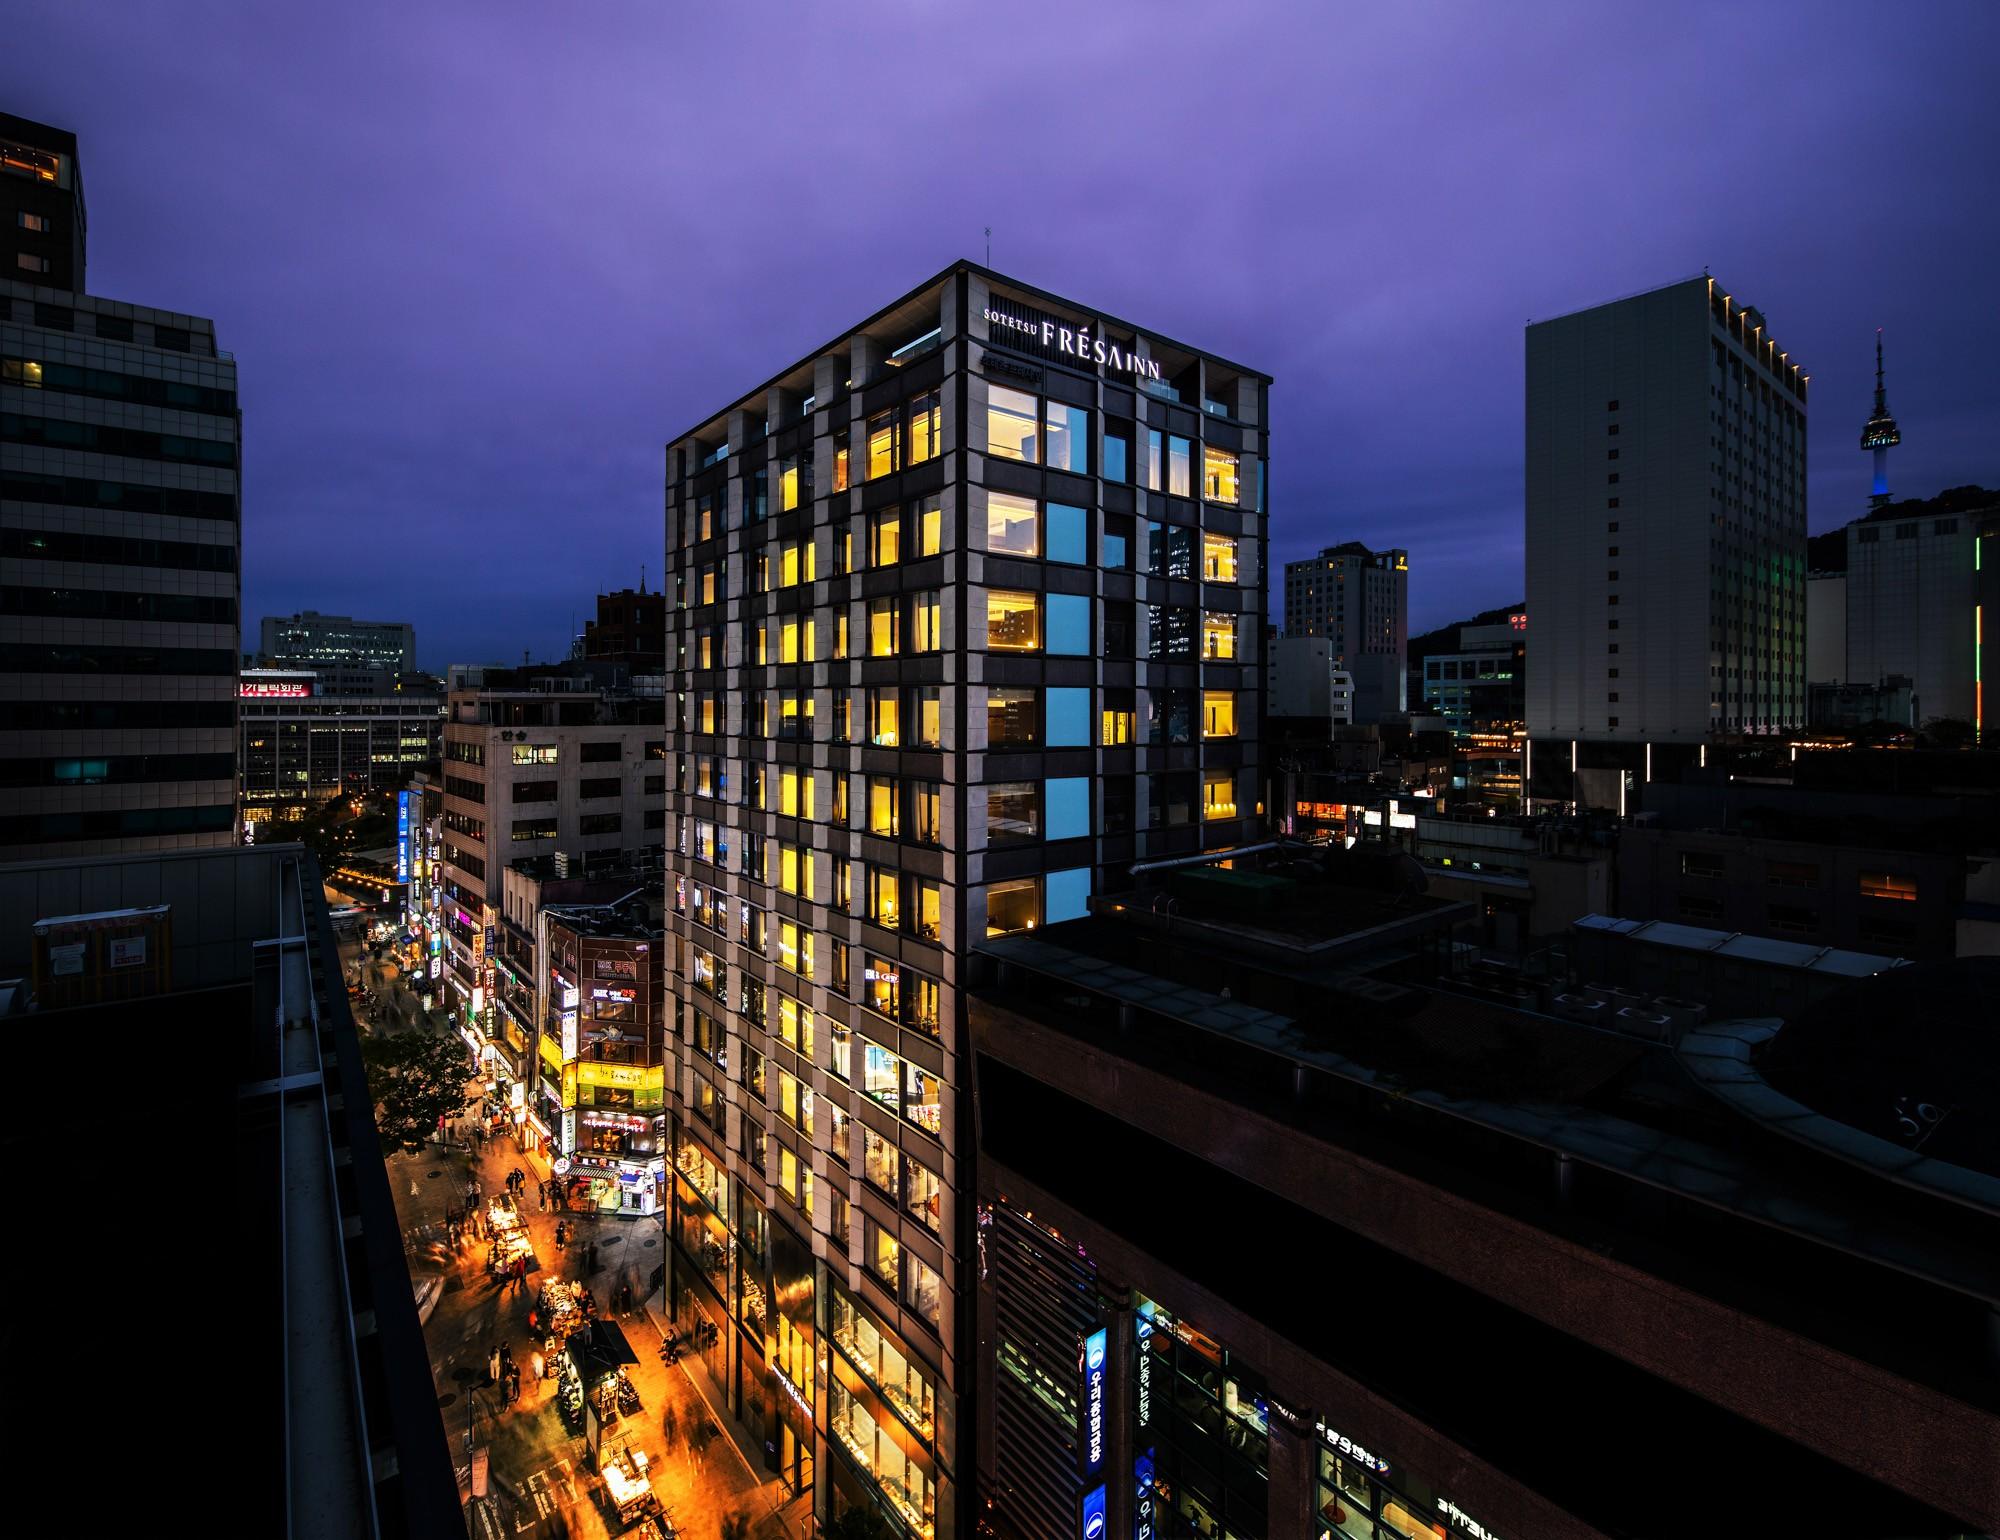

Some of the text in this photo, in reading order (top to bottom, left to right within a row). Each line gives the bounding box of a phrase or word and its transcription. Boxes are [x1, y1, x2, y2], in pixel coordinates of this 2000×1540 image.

[983, 308, 1160, 380] SOTETSU FRÉSA INN
